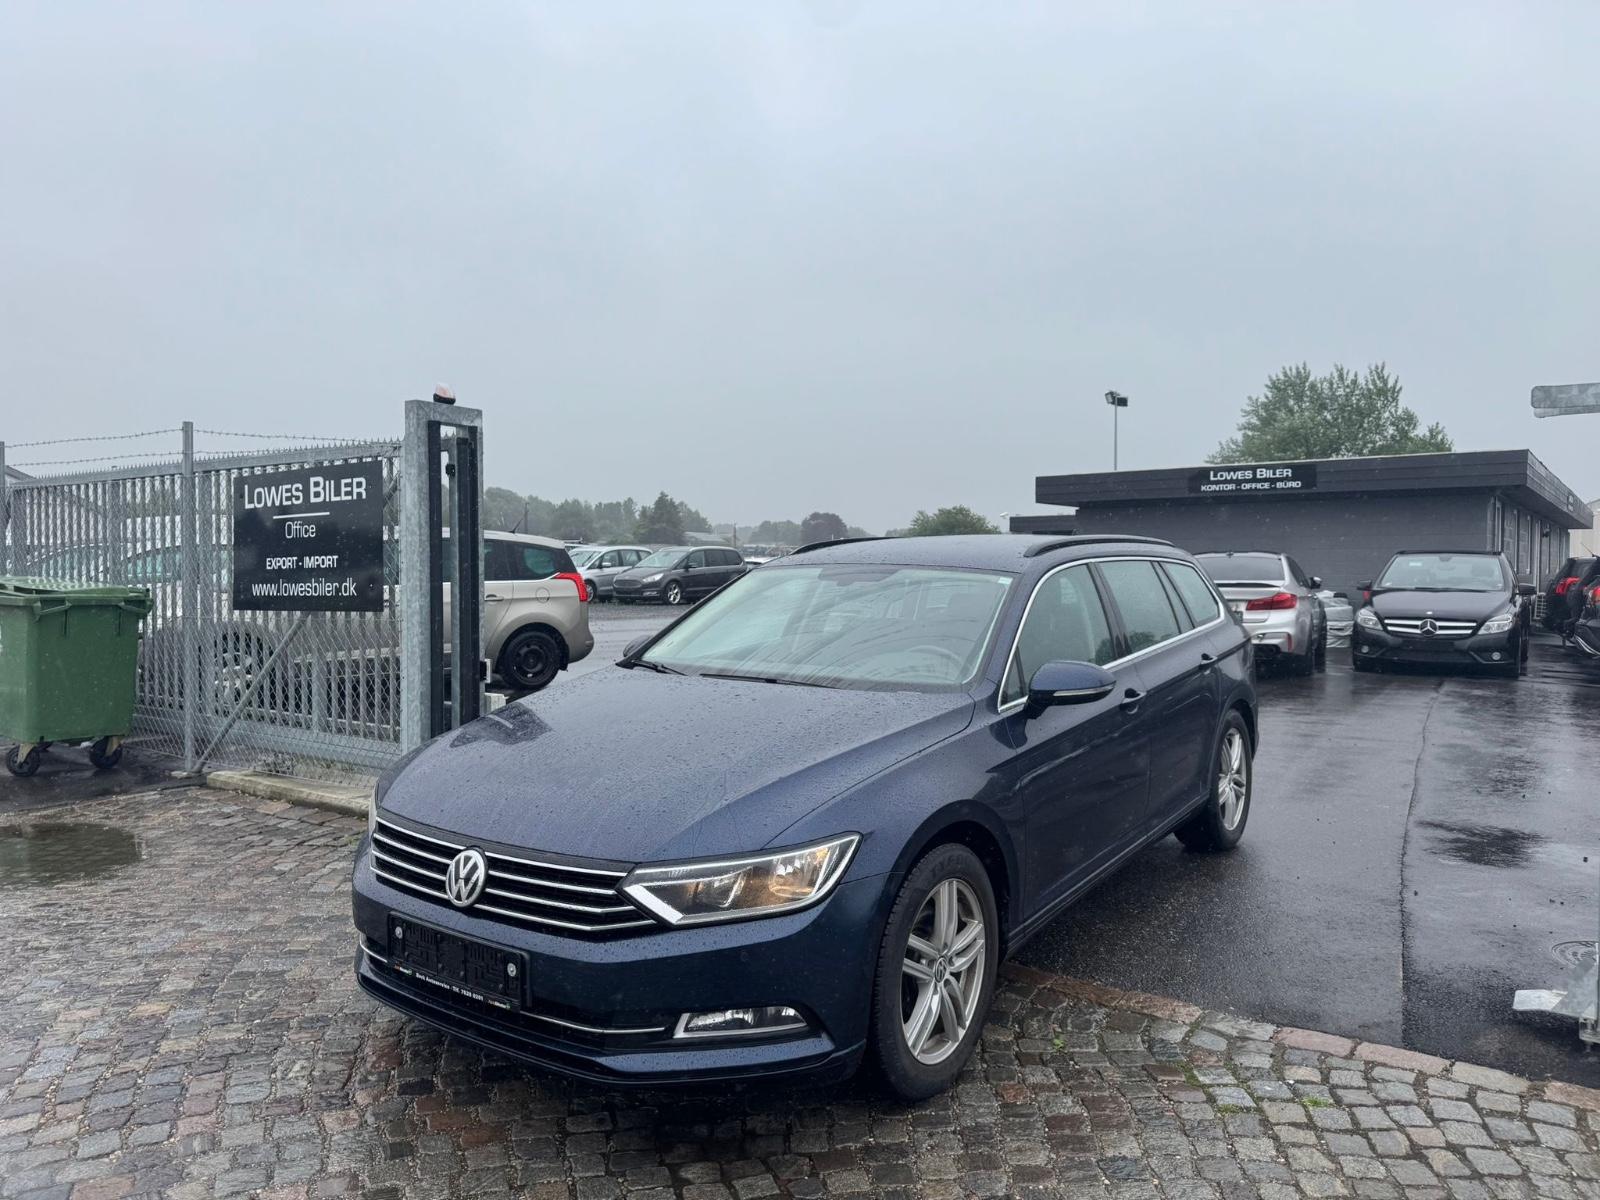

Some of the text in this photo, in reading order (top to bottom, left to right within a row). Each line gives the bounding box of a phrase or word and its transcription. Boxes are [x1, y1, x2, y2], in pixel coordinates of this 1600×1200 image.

[1210, 468, 1292, 481] LOWES BILER
[244, 476, 367, 509] LOWES BILER
[1201, 484, 1236, 492] KONTOR
[1241, 482, 1271, 490] OFFICE
[1276, 480, 1302, 489] BÜRO
[285, 521, 316, 539] Office
[266, 556, 298, 570] EXPORT
[304, 555, 338, 569] IMPORT
[252, 577, 357, 597] www.lowesbiler.dk
